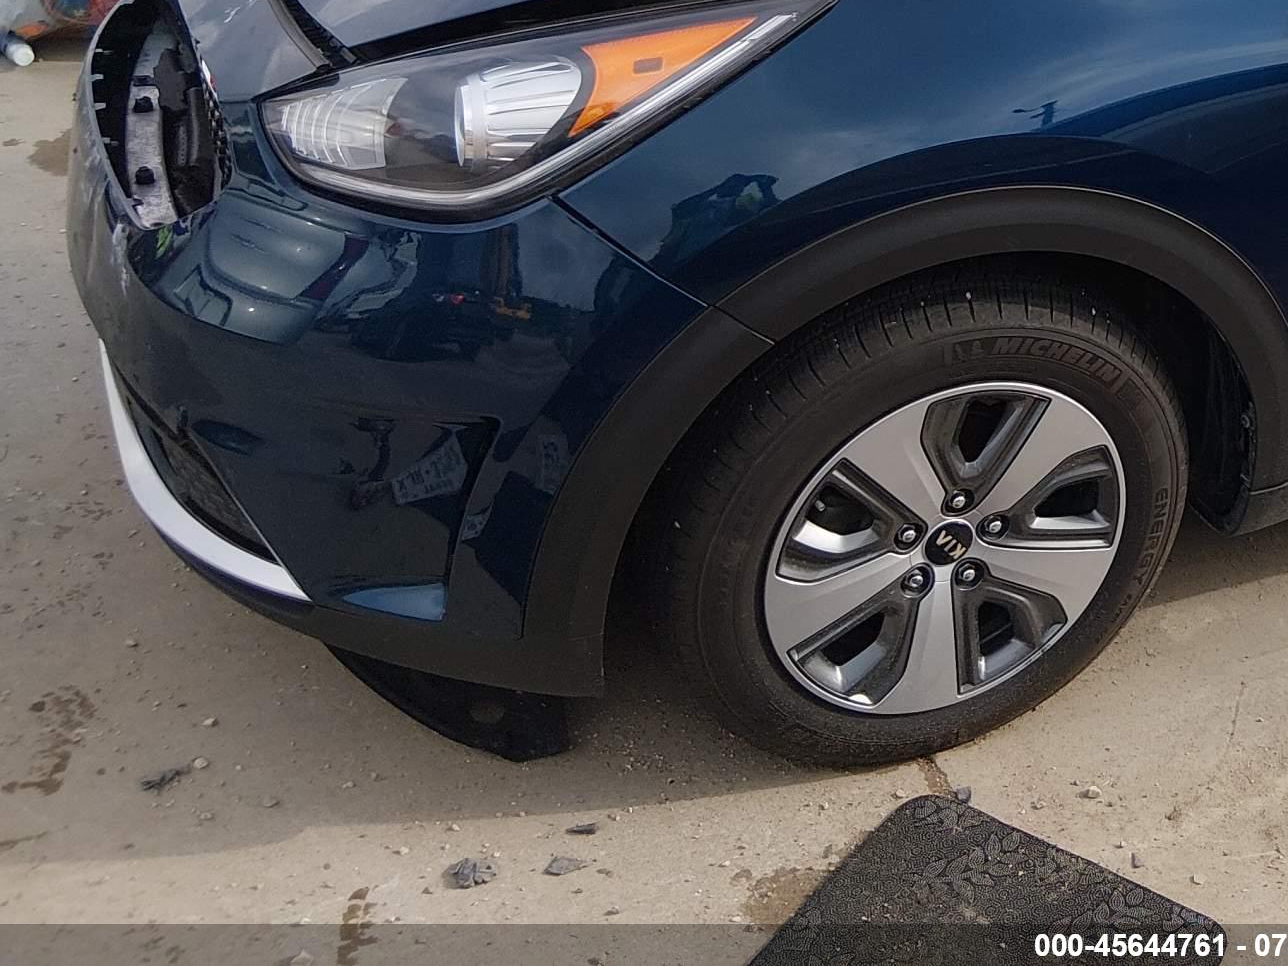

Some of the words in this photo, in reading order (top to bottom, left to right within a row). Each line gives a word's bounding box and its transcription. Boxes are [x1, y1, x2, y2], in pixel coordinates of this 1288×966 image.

[991, 336, 1125, 382] MICHELIN
[935, 529, 967, 560] KIA
[1135, 486, 1170, 585] ENERGY
